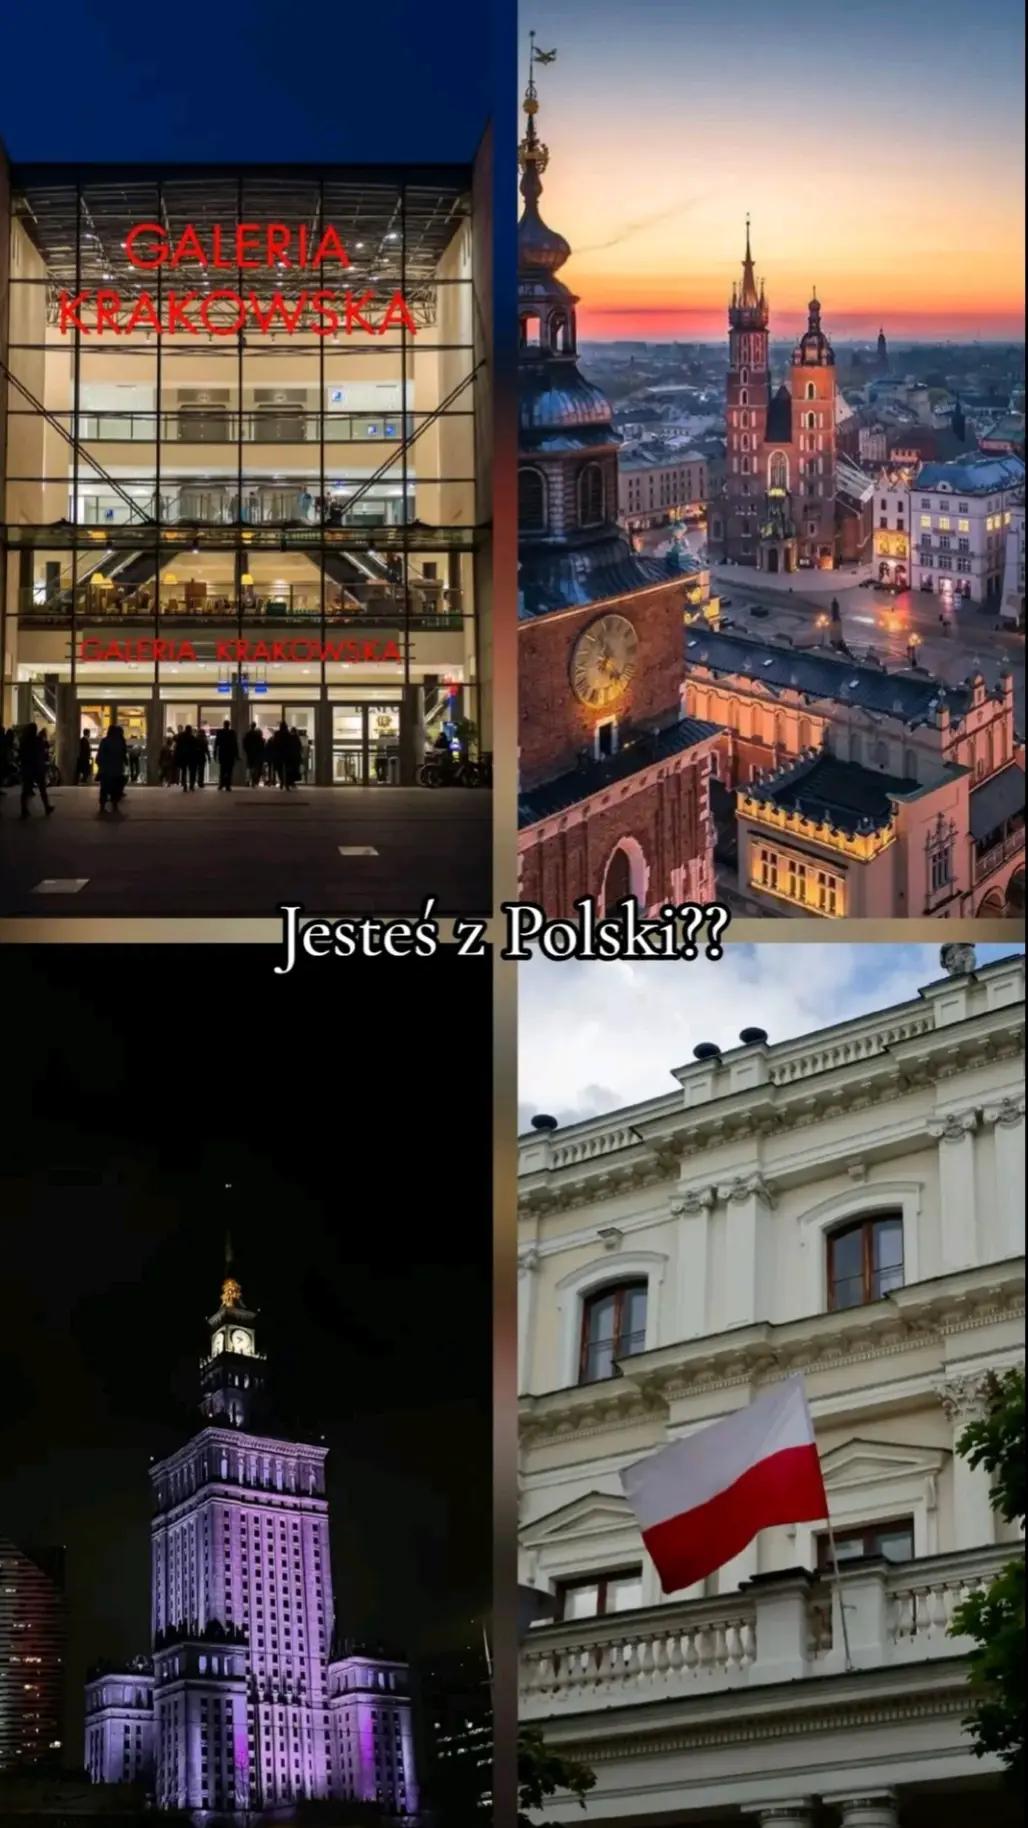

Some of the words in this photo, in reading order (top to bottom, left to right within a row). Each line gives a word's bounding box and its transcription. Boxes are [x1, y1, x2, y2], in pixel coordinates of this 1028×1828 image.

[123, 223, 351, 269] GALERIA
[58, 289, 417, 337] KRAKOWSKA
[79, 639, 197, 662] GALERIA
[216, 639, 402, 663] KRAKOWSKA
